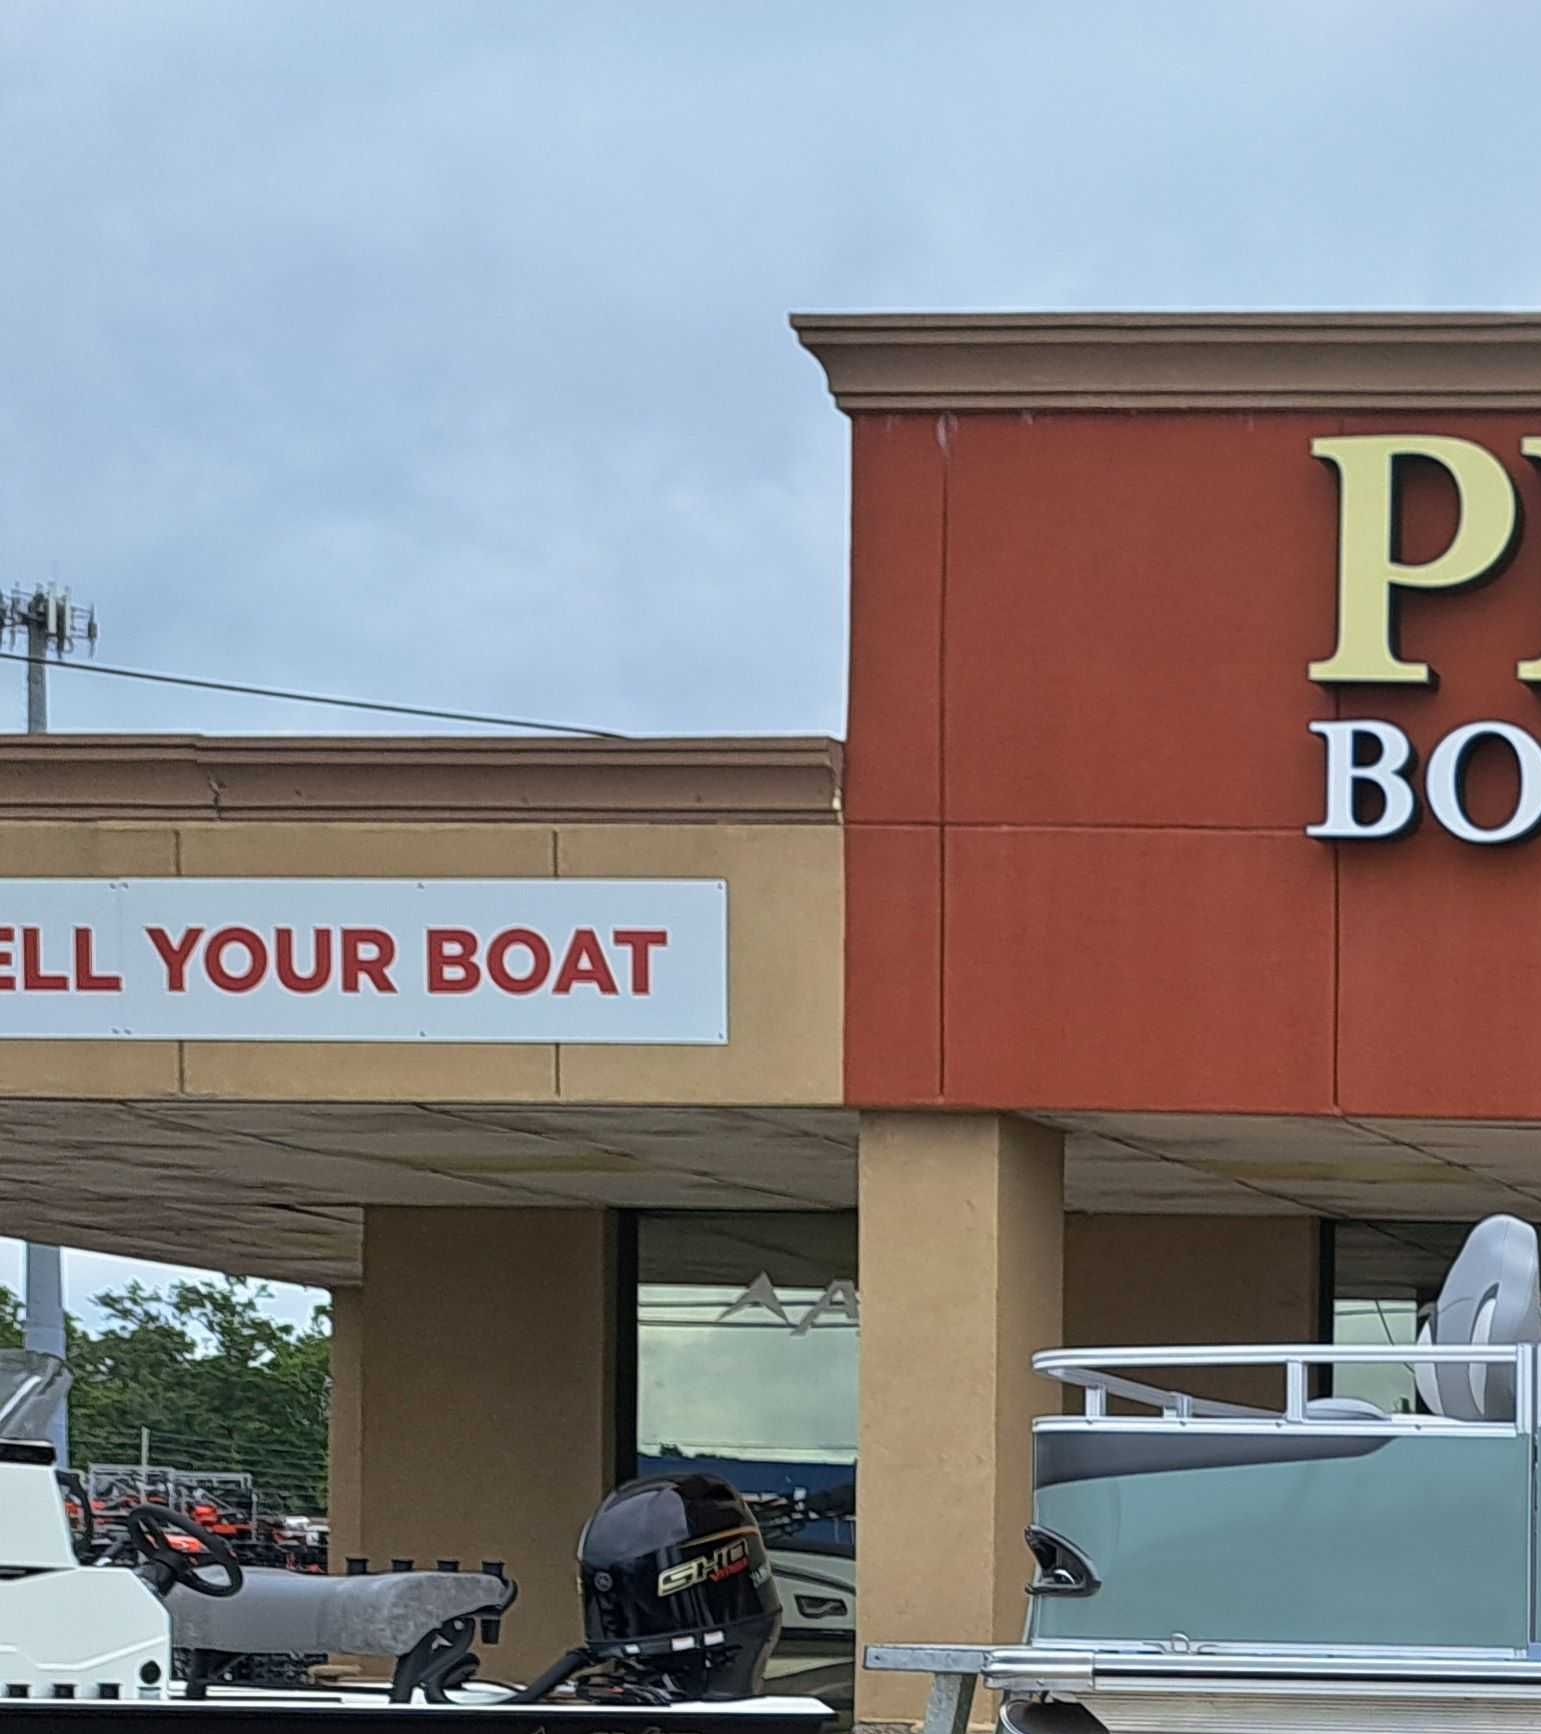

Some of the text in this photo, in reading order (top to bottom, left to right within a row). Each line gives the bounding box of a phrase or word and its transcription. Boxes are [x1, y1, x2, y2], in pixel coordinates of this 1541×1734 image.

[0, 926, 668, 996] LL YOUR BOAT
